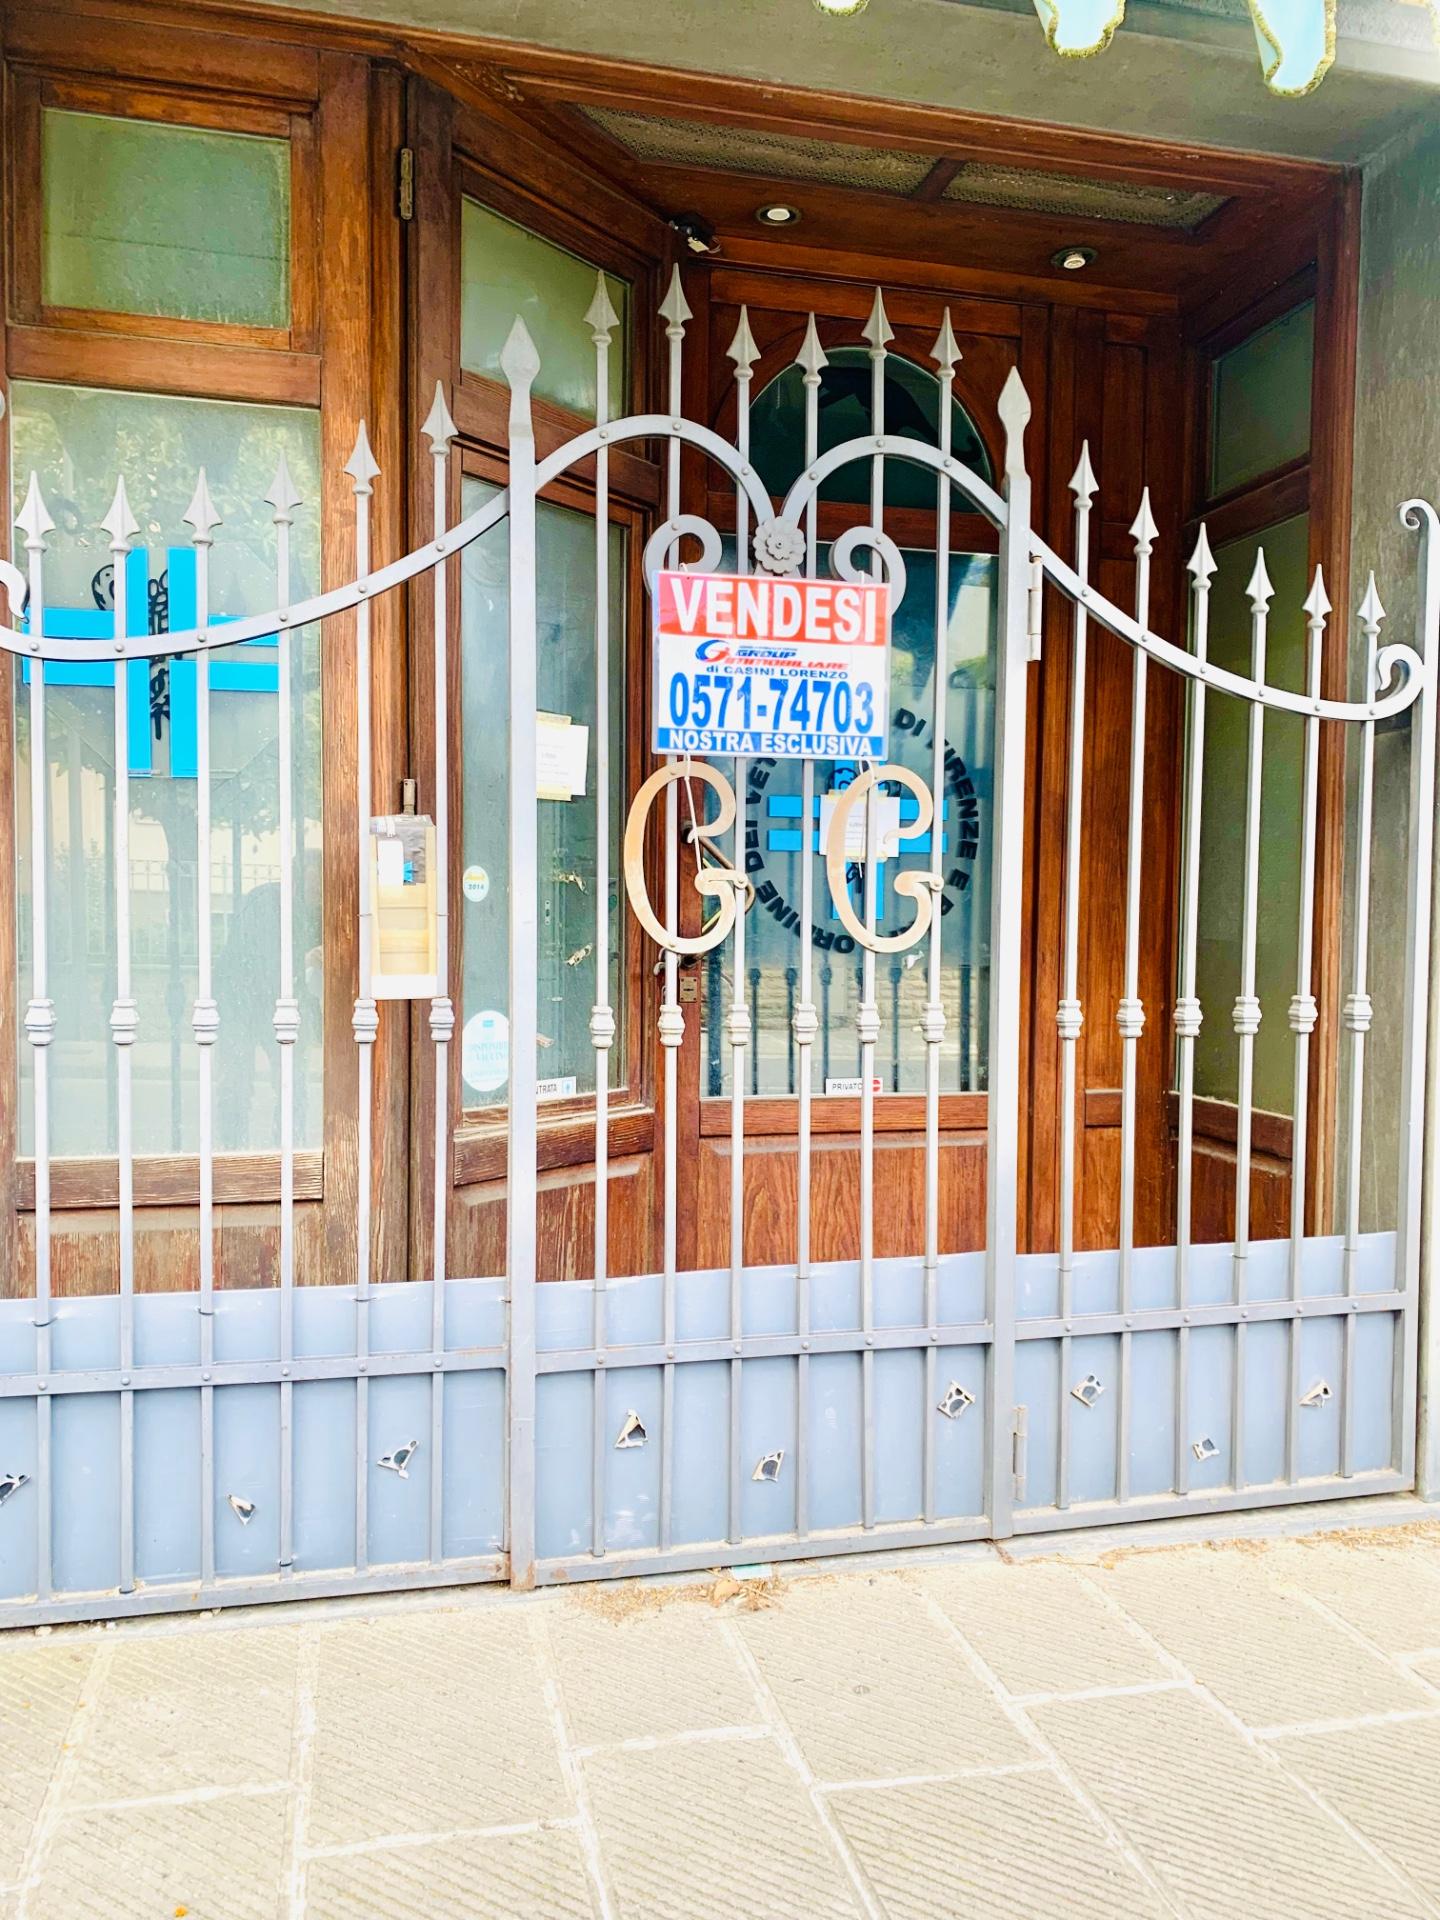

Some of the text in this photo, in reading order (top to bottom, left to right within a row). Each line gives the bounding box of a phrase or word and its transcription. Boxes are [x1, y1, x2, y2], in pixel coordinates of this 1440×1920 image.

[670, 578, 876, 643] VENDESI
[706, 665, 849, 680] di CASINI LORENZO
[736, 649, 798, 659] GROUP
[670, 672, 874, 734] 0571-74703
[669, 730, 873, 756] NOSTRA ESCLUSIVA
[892, 707, 926, 737] DI
[926, 738, 979, 859] IRENZE
